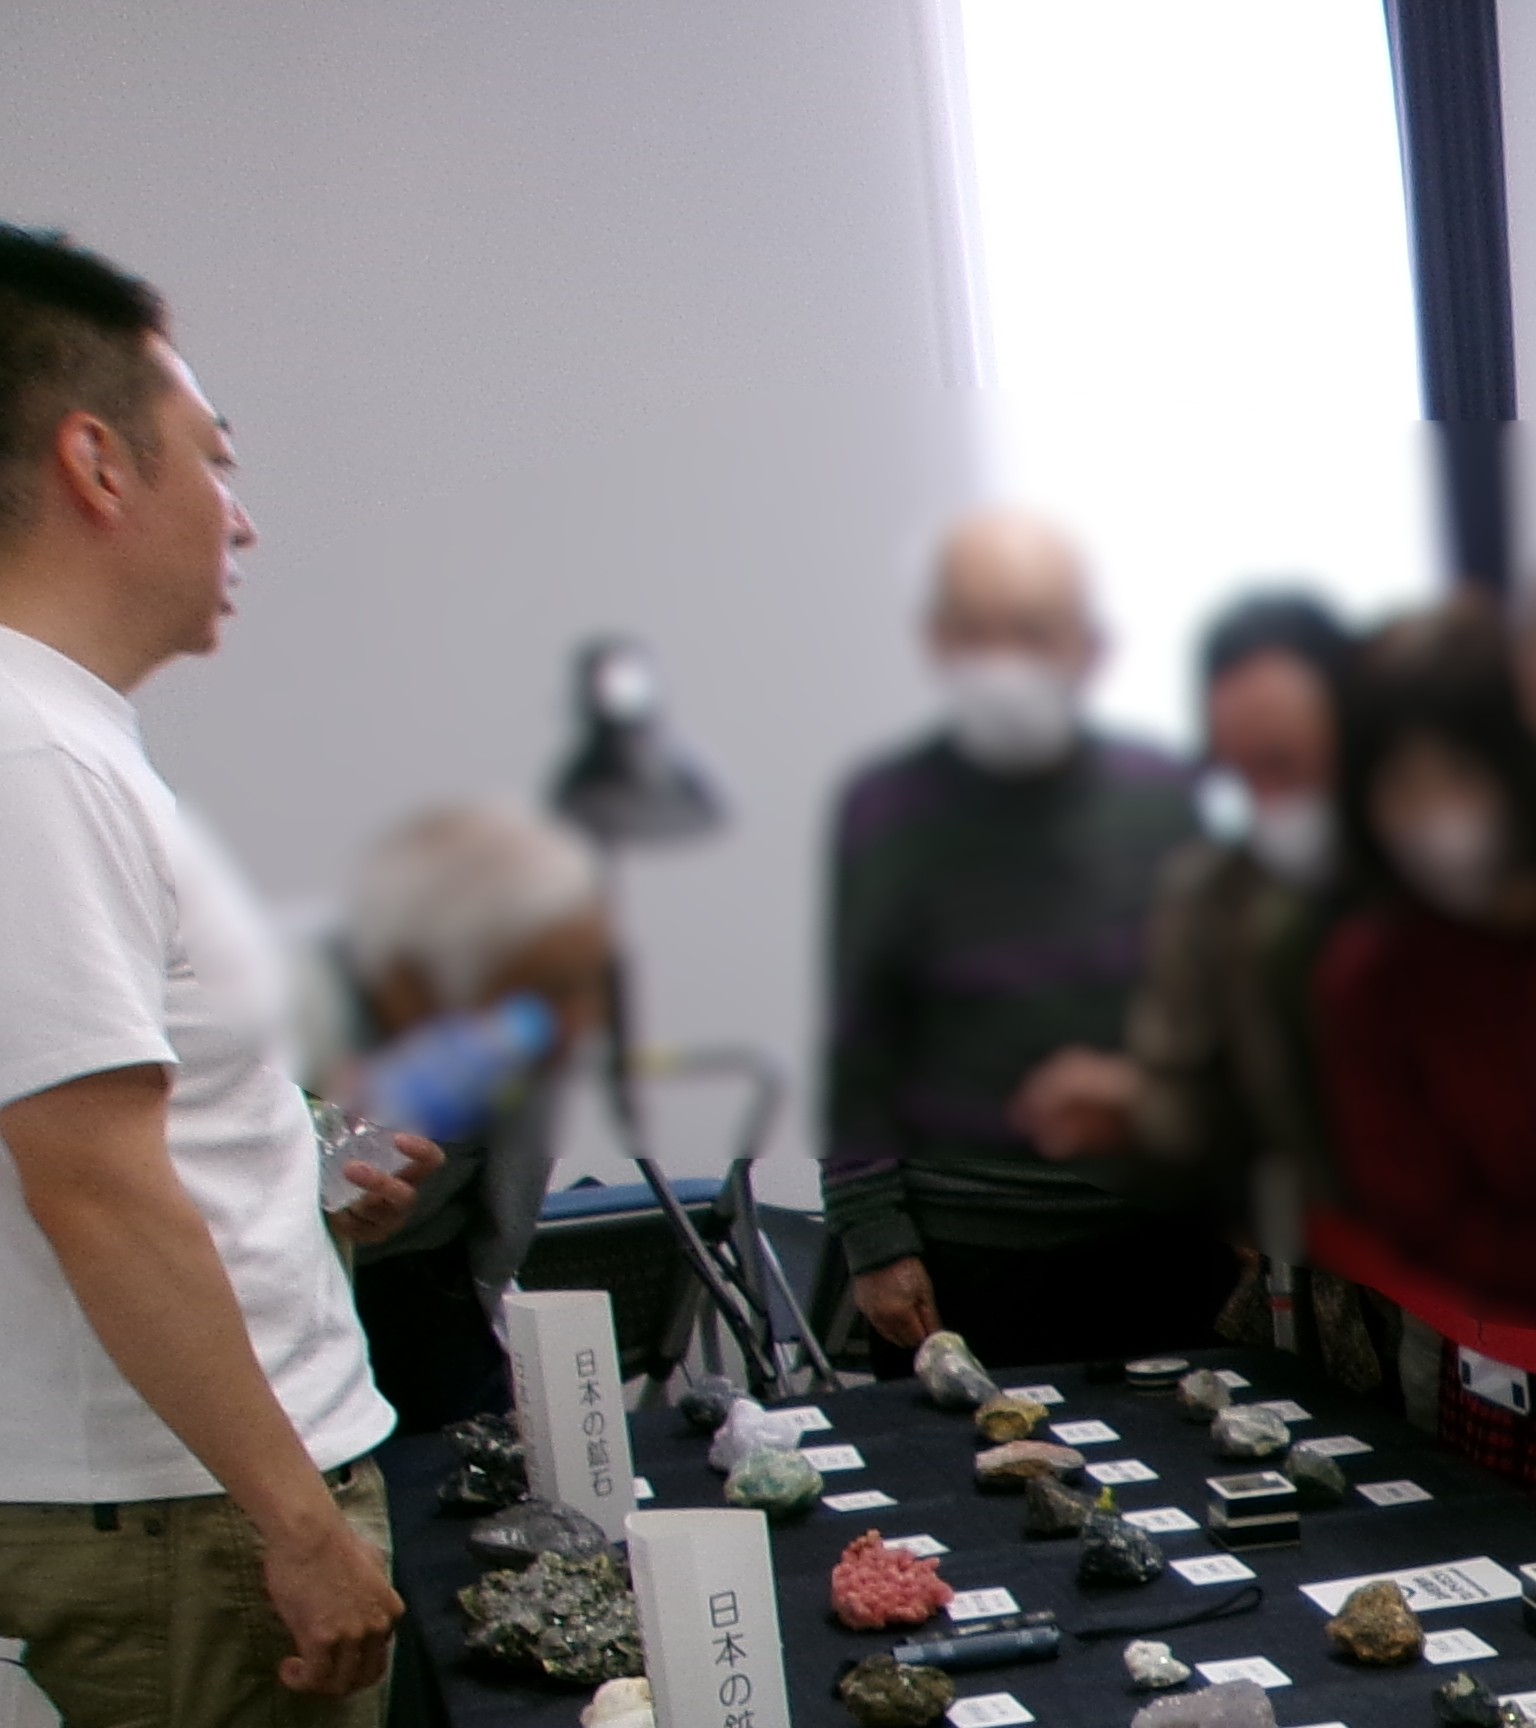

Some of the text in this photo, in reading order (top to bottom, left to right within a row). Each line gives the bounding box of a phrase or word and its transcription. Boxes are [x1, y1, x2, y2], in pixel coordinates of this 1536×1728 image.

[576, 1349, 613, 1498] 日本の鉱石
